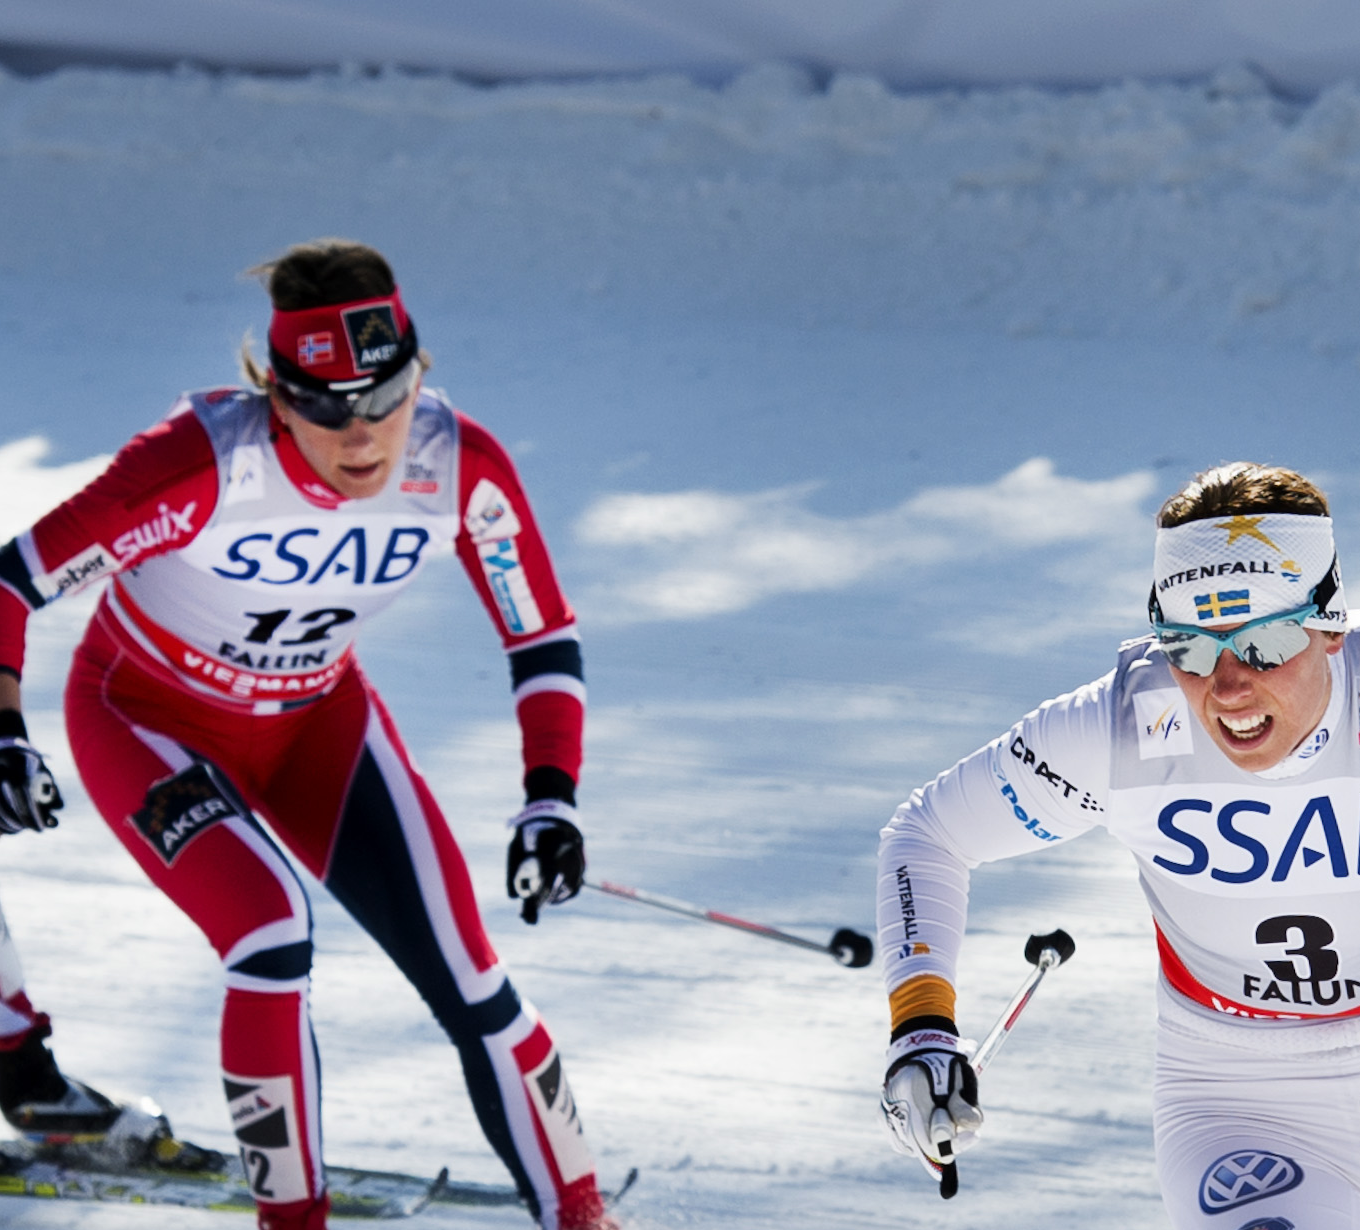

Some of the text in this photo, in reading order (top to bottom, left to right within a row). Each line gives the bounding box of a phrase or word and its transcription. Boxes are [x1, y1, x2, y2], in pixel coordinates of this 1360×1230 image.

[212, 527, 429, 584] SSAB
[1158, 561, 1276, 593] VATTENFALL
[218, 641, 326, 668] FALUN
[245, 608, 356, 645] 12
[1010, 736, 1078, 798] CRAFT
[163, 797, 228, 851] AKER
[1001, 783, 1063, 841] Polar
[896, 865, 918, 939] VATTENFALL
[1255, 915, 1339, 982] 3
